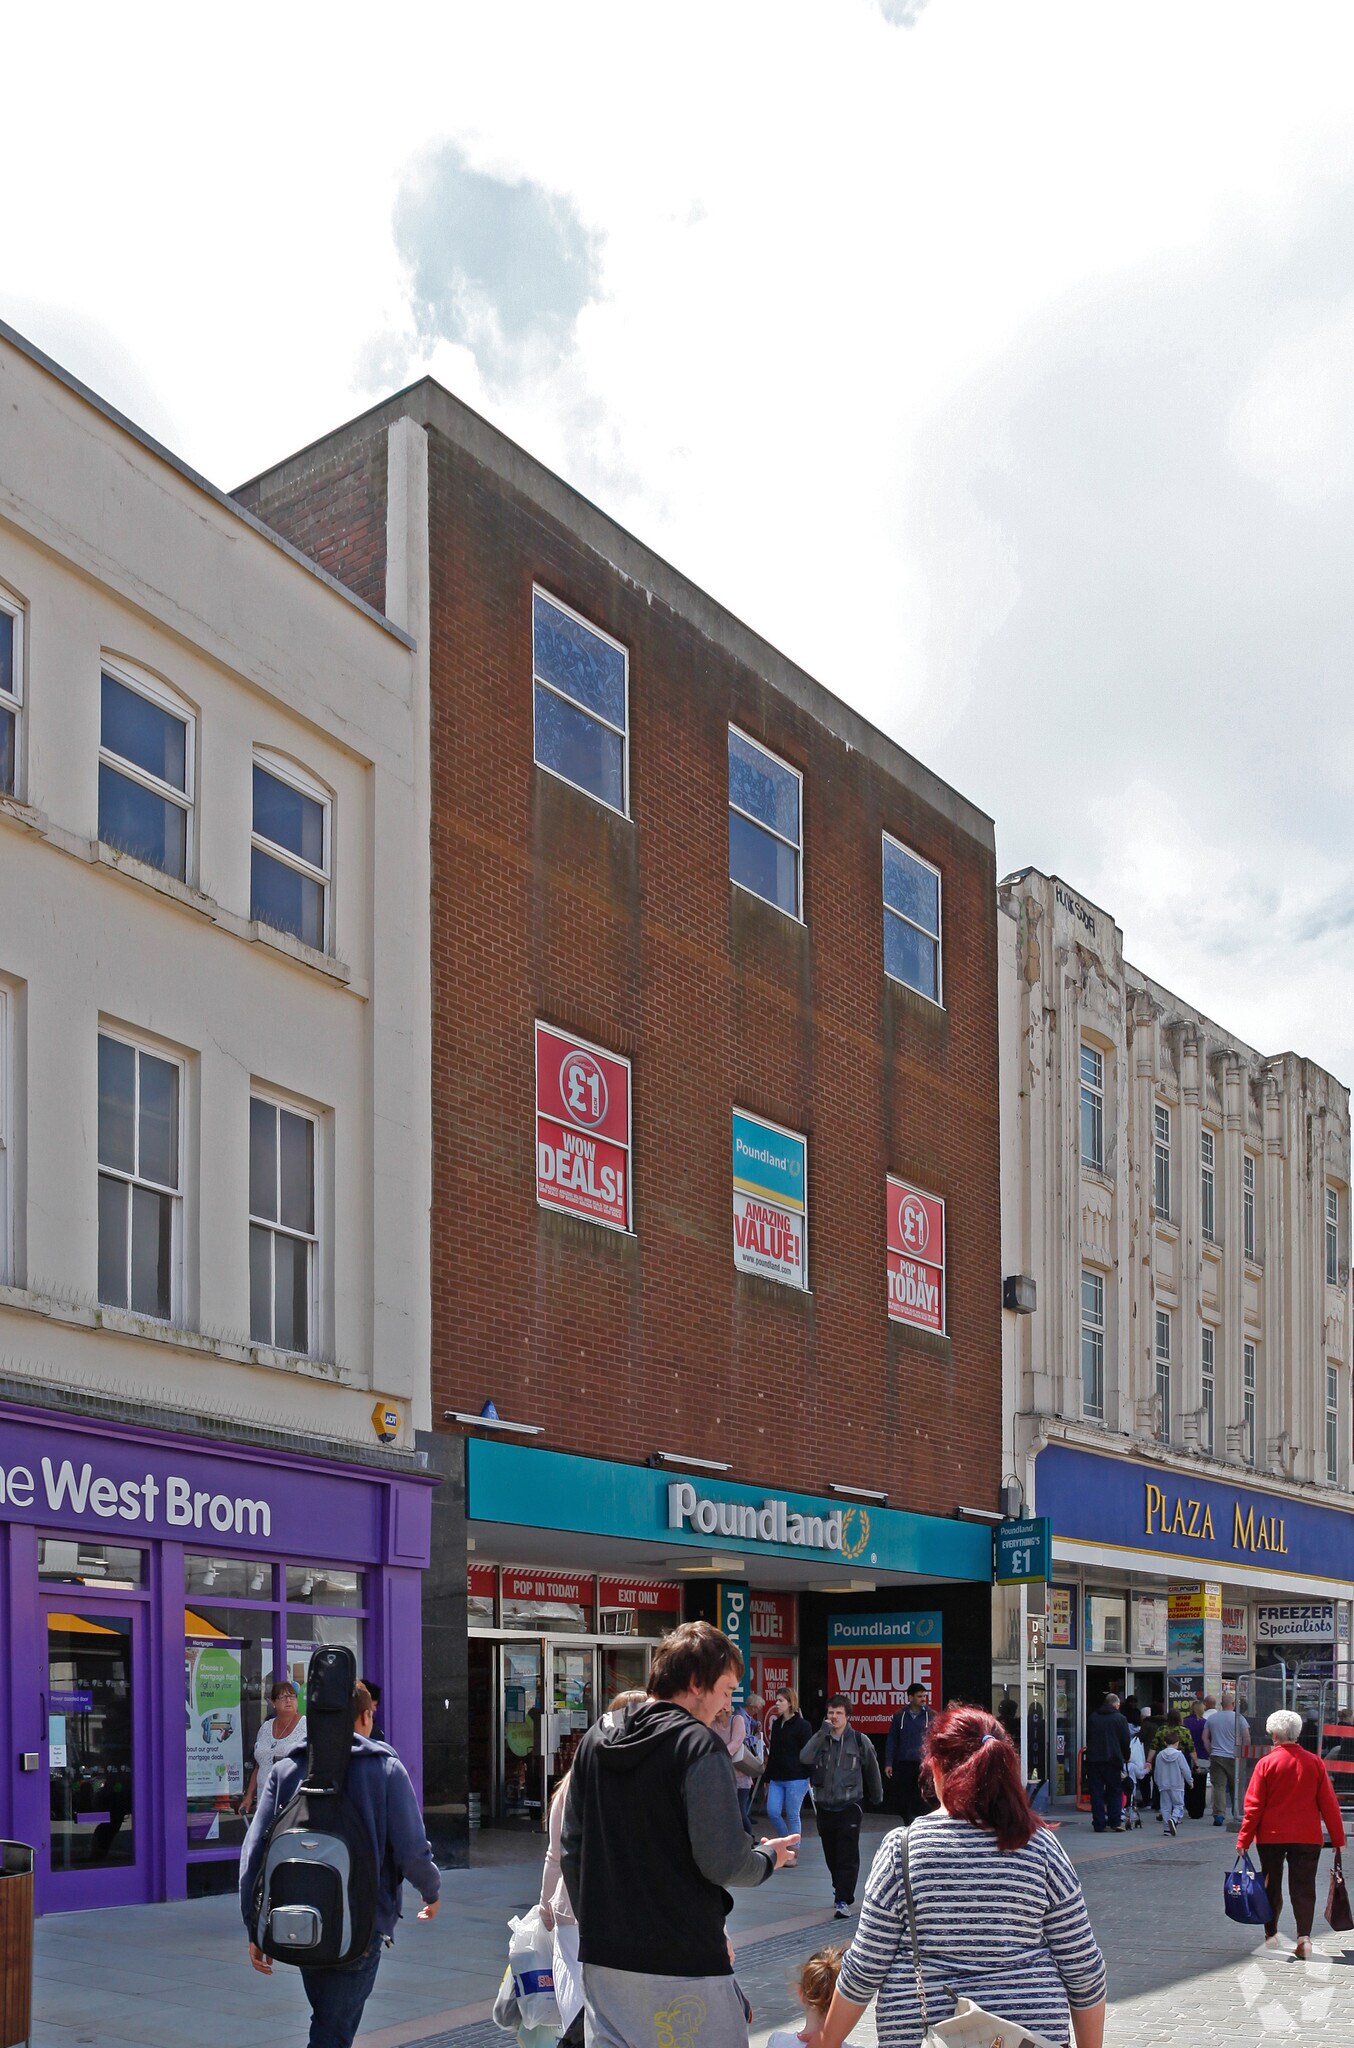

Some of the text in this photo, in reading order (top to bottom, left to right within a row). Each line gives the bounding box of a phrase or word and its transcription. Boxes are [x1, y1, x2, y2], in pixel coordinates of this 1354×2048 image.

[568, 1065, 599, 1117] £1
[562, 1132, 596, 1162] WOW
[736, 1138, 787, 1171] Poundland
[538, 1141, 624, 1206] DEALS!
[745, 1202, 791, 1233] AMAZING
[904, 1206, 924, 1246] £1
[734, 1214, 800, 1266] VALUE!
[742, 1253, 792, 1275] www.poundland.com
[900, 1260, 926, 1283] POP IN
[887, 1269, 938, 1315] TODAY!
[41, 1456, 160, 1523] West
[166, 1476, 271, 1537] Brom
[668, 1483, 843, 1550] Poundland
[1000, 1523, 1033, 1536] Poundland
[1002, 1537, 1041, 1549] EVERYTHING'S
[1012, 1549, 1031, 1574] £1
[513, 1580, 579, 1599] POP IN TODAY!
[618, 1589, 659, 1605] EXIT ONLY
[1258, 1606, 1333, 1620] FREEZER
[834, 1621, 911, 1637] Poundland
[1259, 1619, 1332, 1638] Specialists
[764, 1668, 789, 1681] VALUE
[834, 1657, 932, 1691] VALUE
[862, 1691, 889, 1705] CAN
